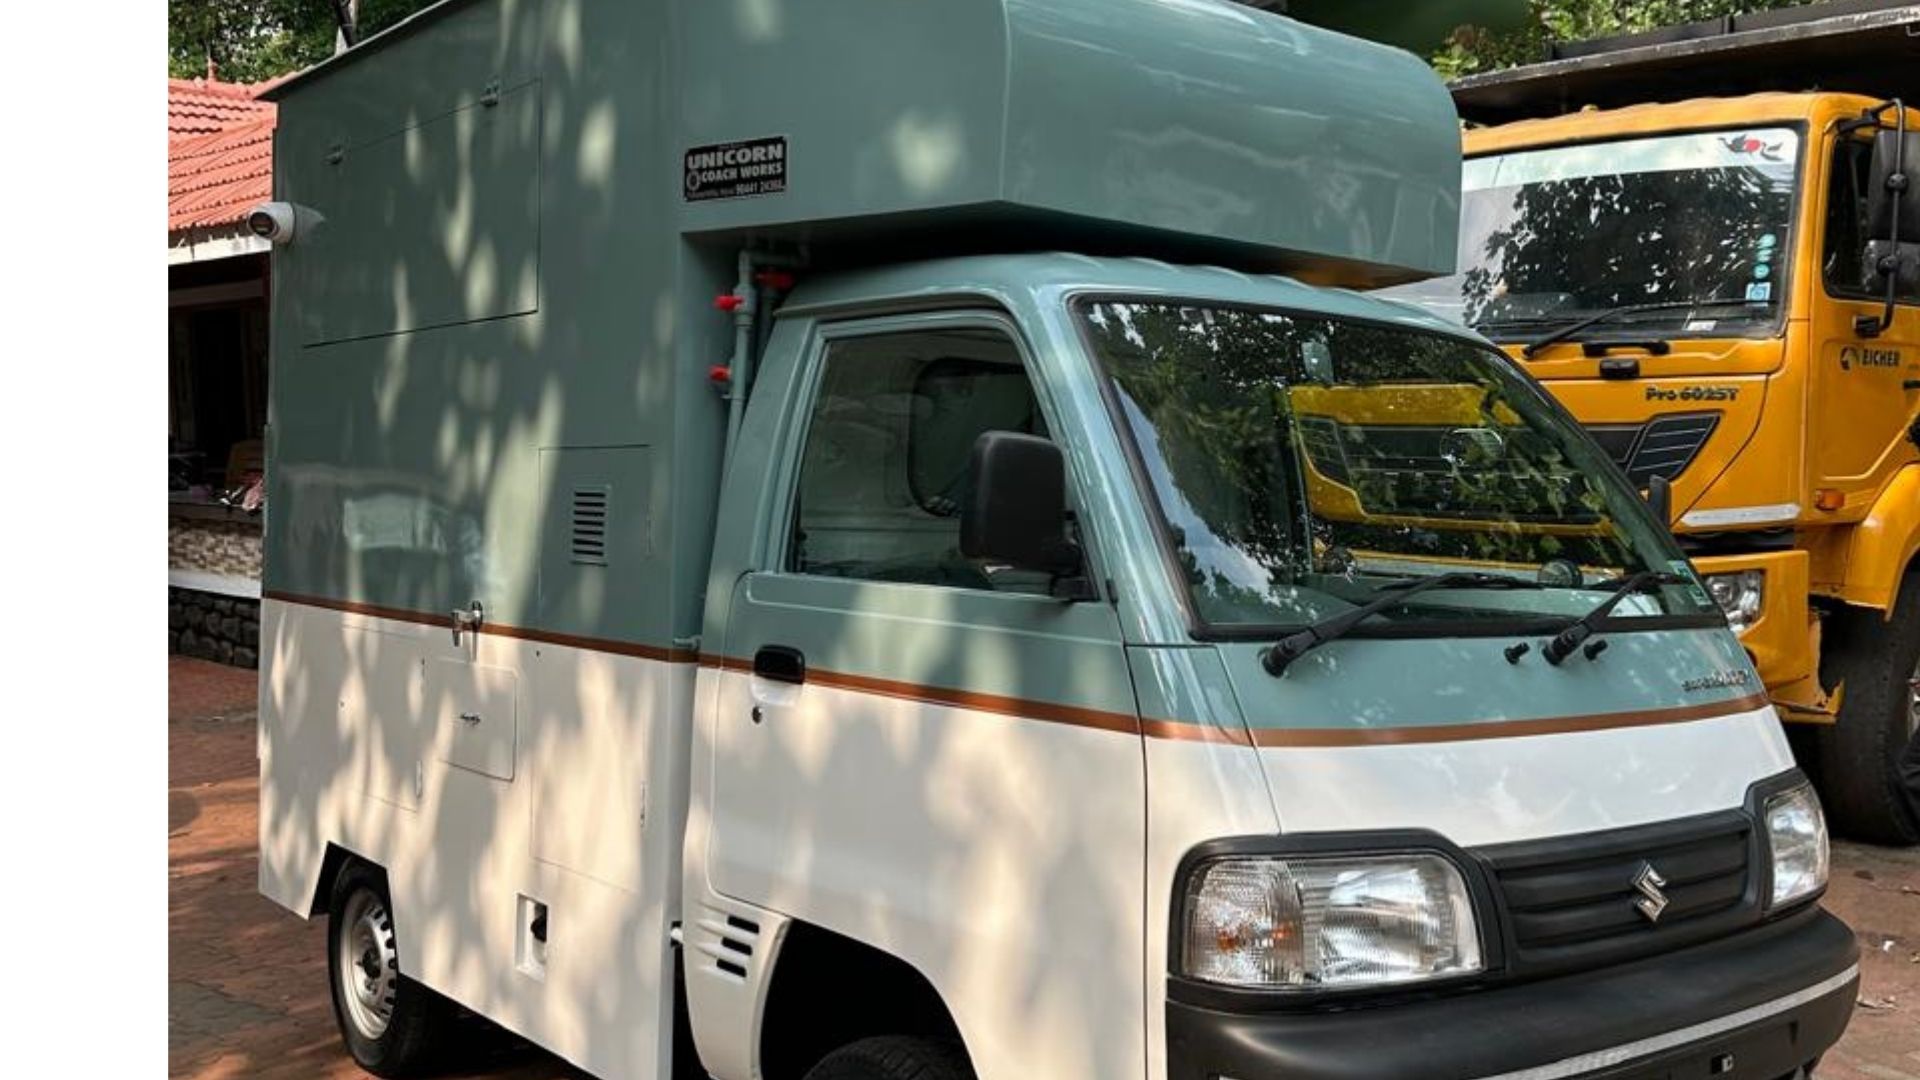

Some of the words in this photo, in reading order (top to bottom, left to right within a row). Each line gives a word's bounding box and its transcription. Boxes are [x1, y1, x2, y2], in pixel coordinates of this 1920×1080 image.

[688, 144, 782, 169] UNICORN
[702, 169, 738, 183] COACH
[741, 163, 782, 178] WORKS
[1862, 349, 1900, 367] EICHER
[1646, 386, 1678, 401] Pro
